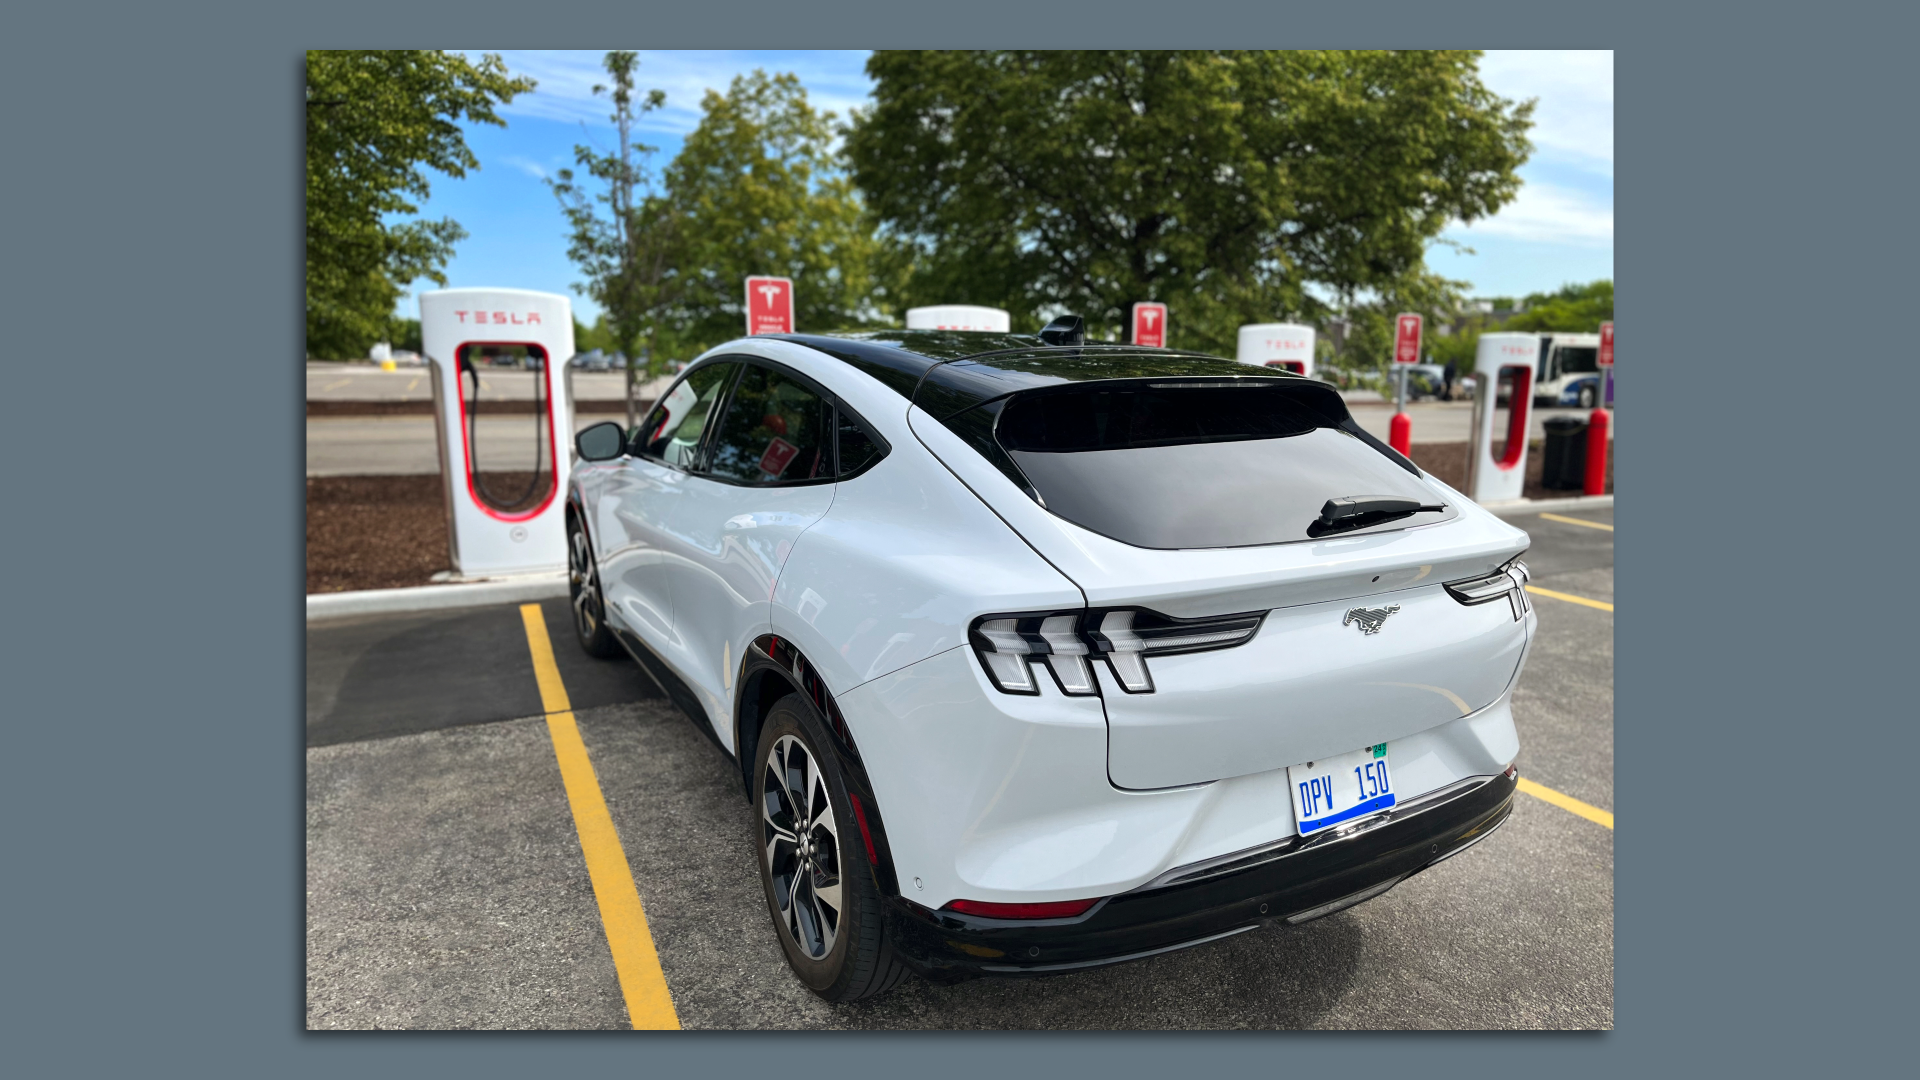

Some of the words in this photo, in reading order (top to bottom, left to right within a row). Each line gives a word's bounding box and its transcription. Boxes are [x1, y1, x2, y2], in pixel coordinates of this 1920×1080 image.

[454, 311, 541, 325] TESLA
[1266, 339, 1305, 350] TESLA
[1299, 775, 1333, 817] DPV
[1355, 760, 1389, 800] 150
